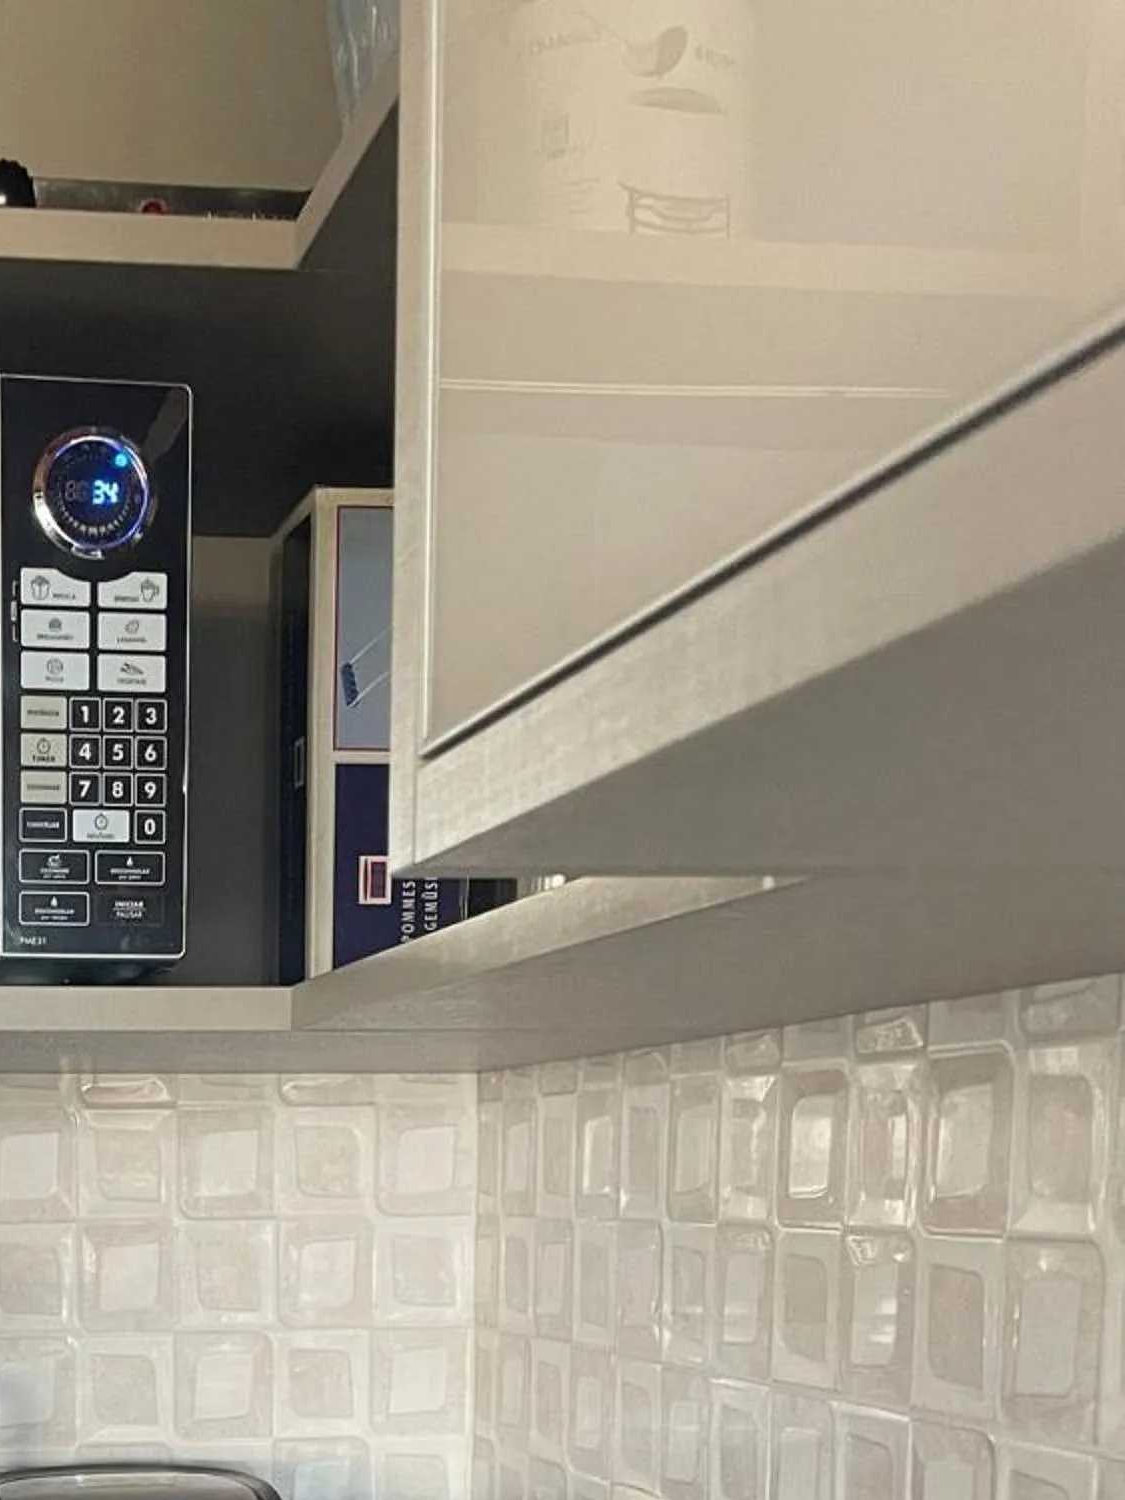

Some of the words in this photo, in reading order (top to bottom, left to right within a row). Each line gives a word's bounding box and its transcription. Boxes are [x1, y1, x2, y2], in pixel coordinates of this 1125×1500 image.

[92, 479, 119, 505] 34
[80, 706, 90, 723] 1
[112, 706, 125, 724] 2
[145, 707, 157, 724] 3
[78, 743, 92, 760] 4
[112, 743, 124, 761] 5
[144, 744, 157, 762] 6
[78, 780, 92, 798] 7
[112, 781, 124, 798] 8
[144, 781, 157, 799] 9
[144, 818, 156, 835] 0
